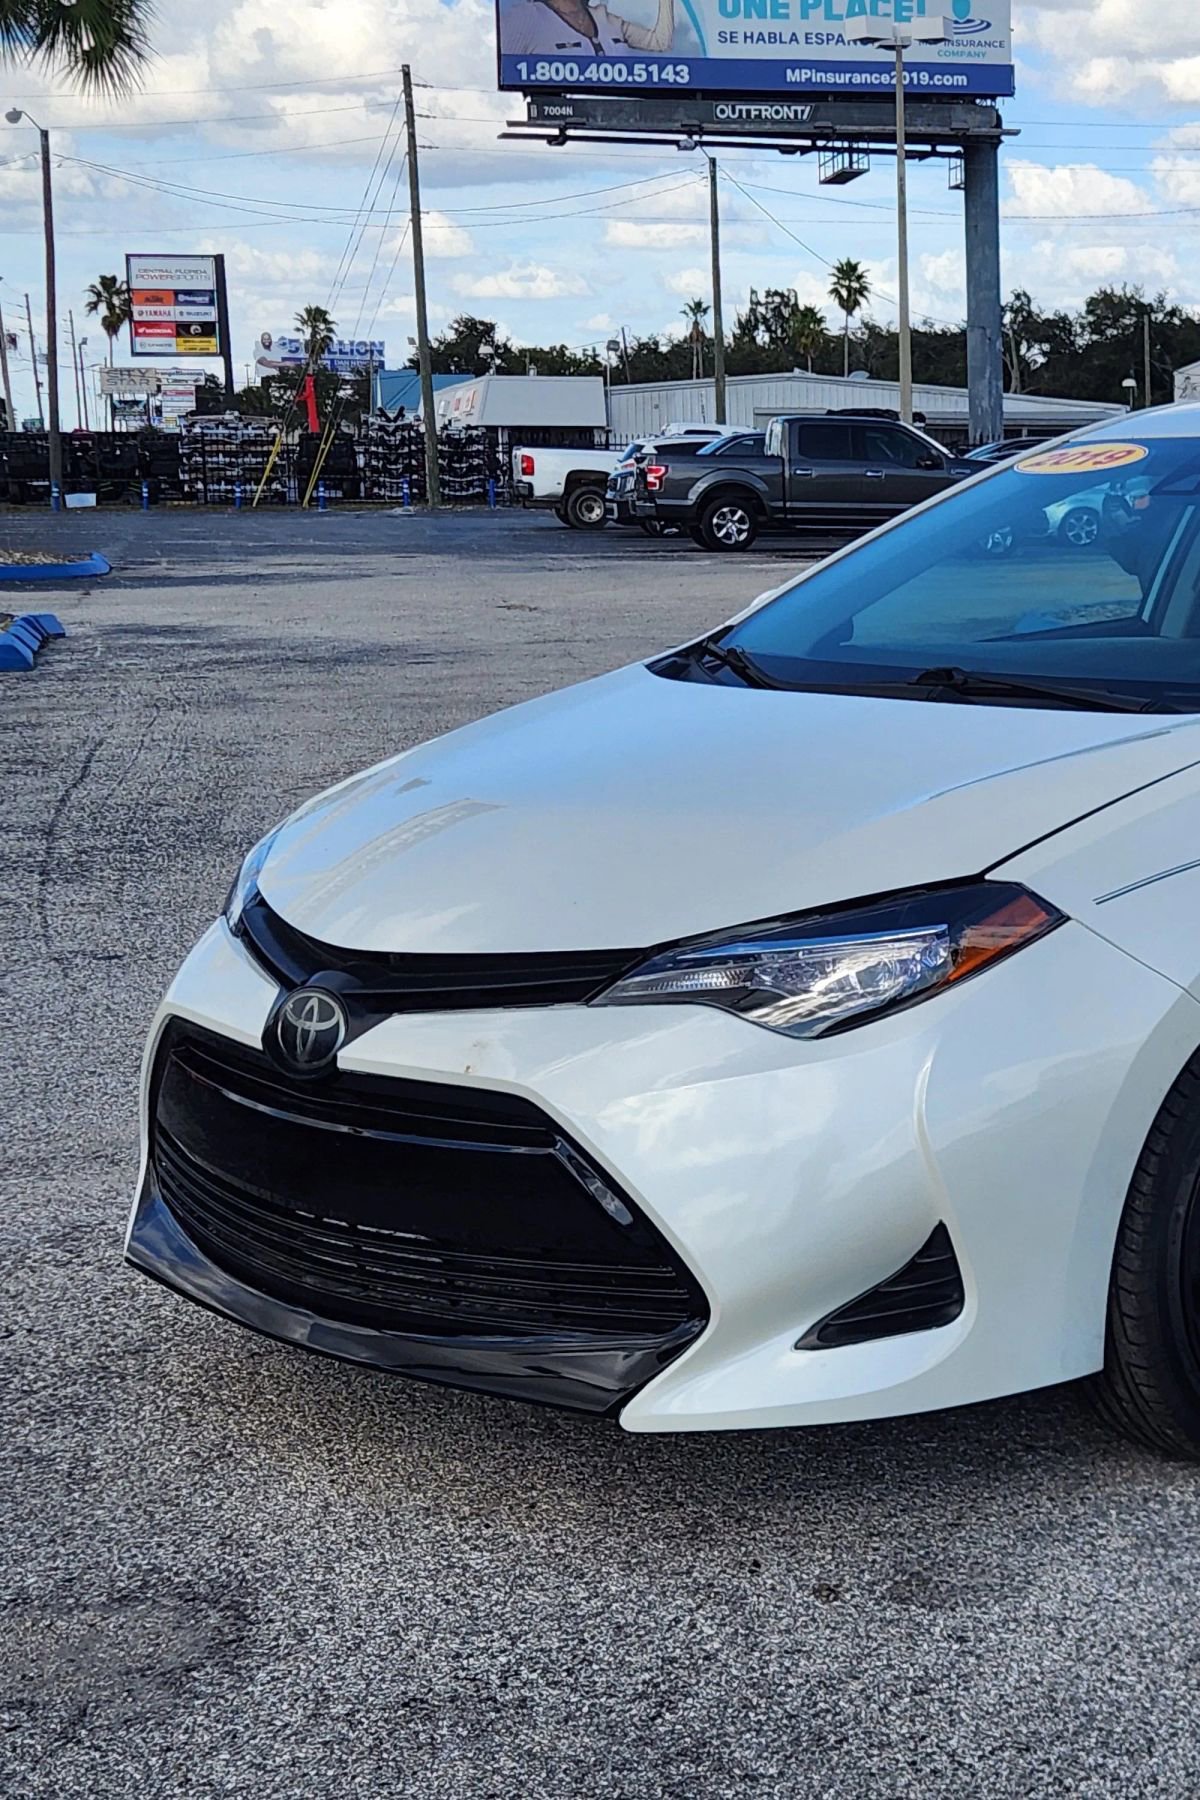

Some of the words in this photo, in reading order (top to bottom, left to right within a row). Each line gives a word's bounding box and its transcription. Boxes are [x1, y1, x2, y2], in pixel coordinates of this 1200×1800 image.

[718, 31, 739, 44] SE
[743, 31, 800, 45] HABLA
[804, 32, 873, 46] ESPA
[937, 49, 986, 58] COMPANY
[516, 62, 690, 84] 1.800.400.5143
[543, 105, 573, 117] 7004N
[143, 309, 171, 317] YAMAHA
[106, 378, 151, 386] STAR
[1024, 449, 1137, 467] 2019
